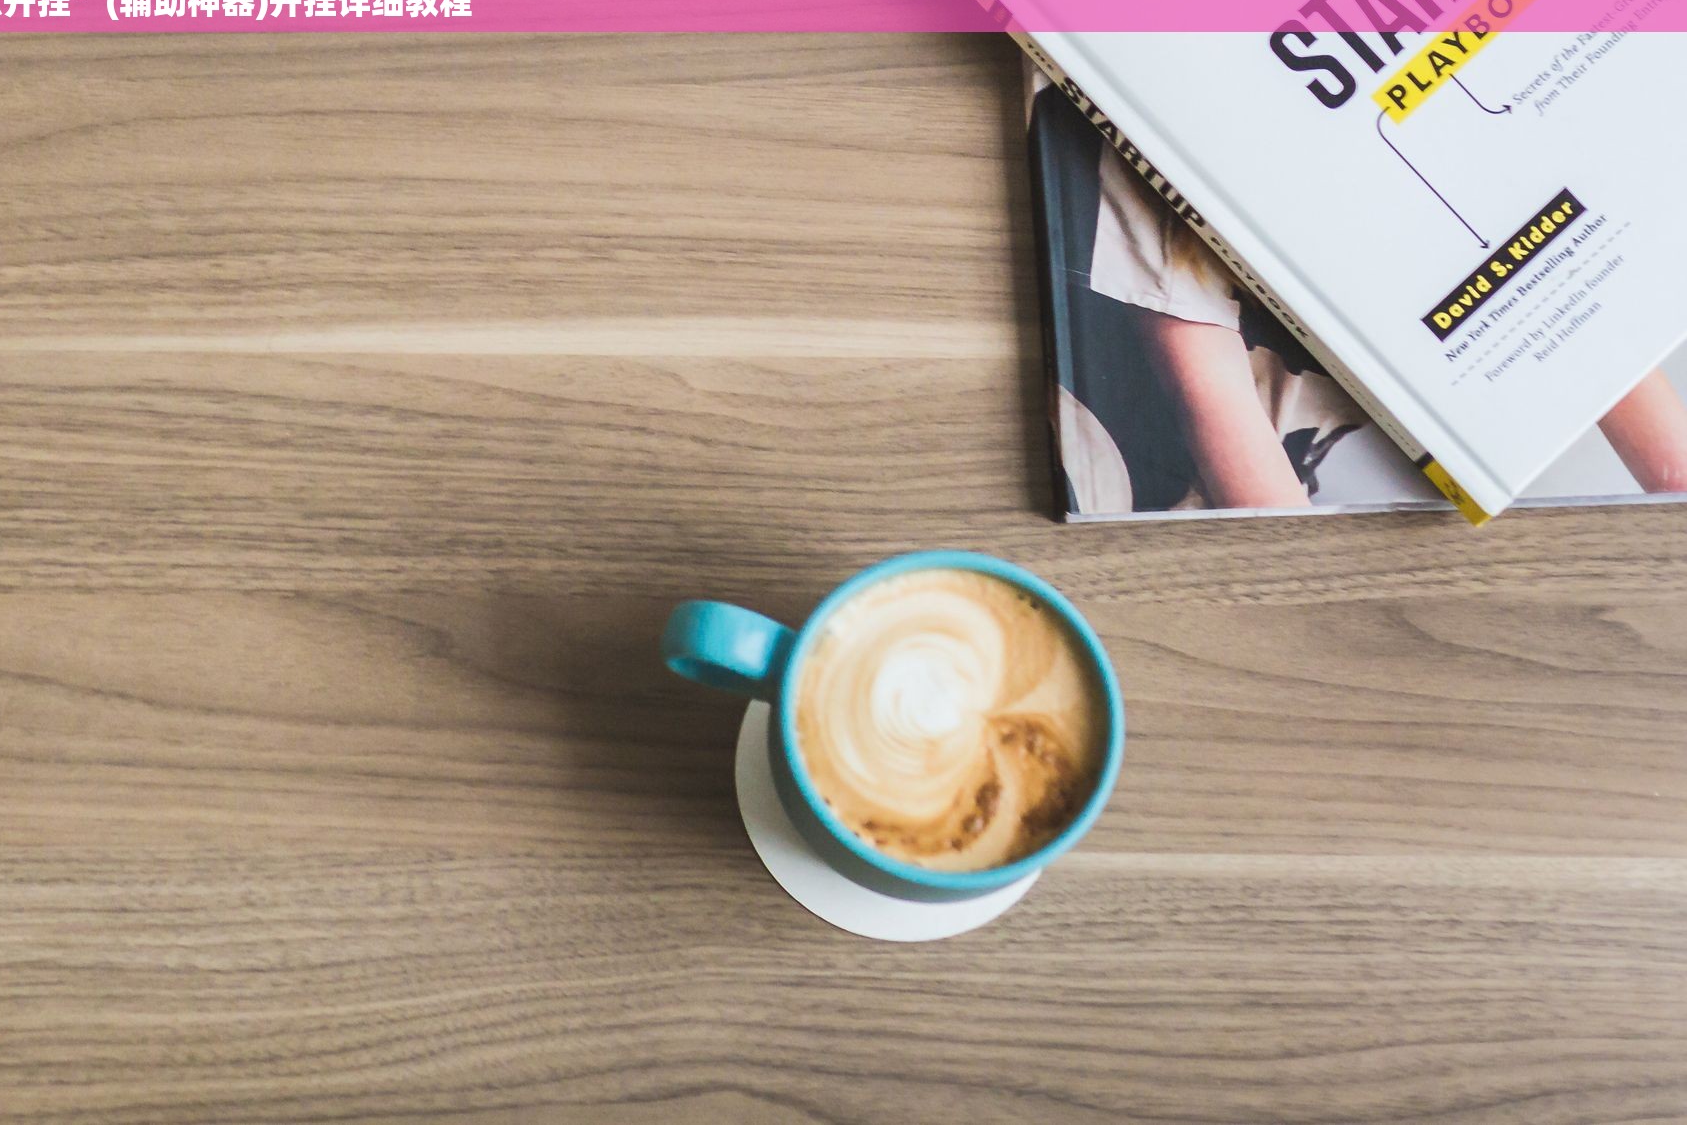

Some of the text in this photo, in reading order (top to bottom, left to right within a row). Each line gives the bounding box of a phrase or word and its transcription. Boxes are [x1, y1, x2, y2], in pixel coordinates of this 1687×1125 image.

[1511, 68, 1551, 106] Secrets
[1547, 56, 1565, 74] of
[1559, 41, 1580, 61] the
[1531, 85, 1562, 115] from
[1556, 61, 1588, 92] Their
[1585, 16, 1637, 66] Founding
[1054, 74, 1310, 340] STARTUP PLAYBOOK
[1432, 201, 1574, 329] David S. Kidder
[1444, 211, 1608, 363] New York Times Bestselling Author
[1484, 252, 1625, 383] Foreword by LinkedIn founder
[1533, 299, 1602, 363] Reid Hoffman
